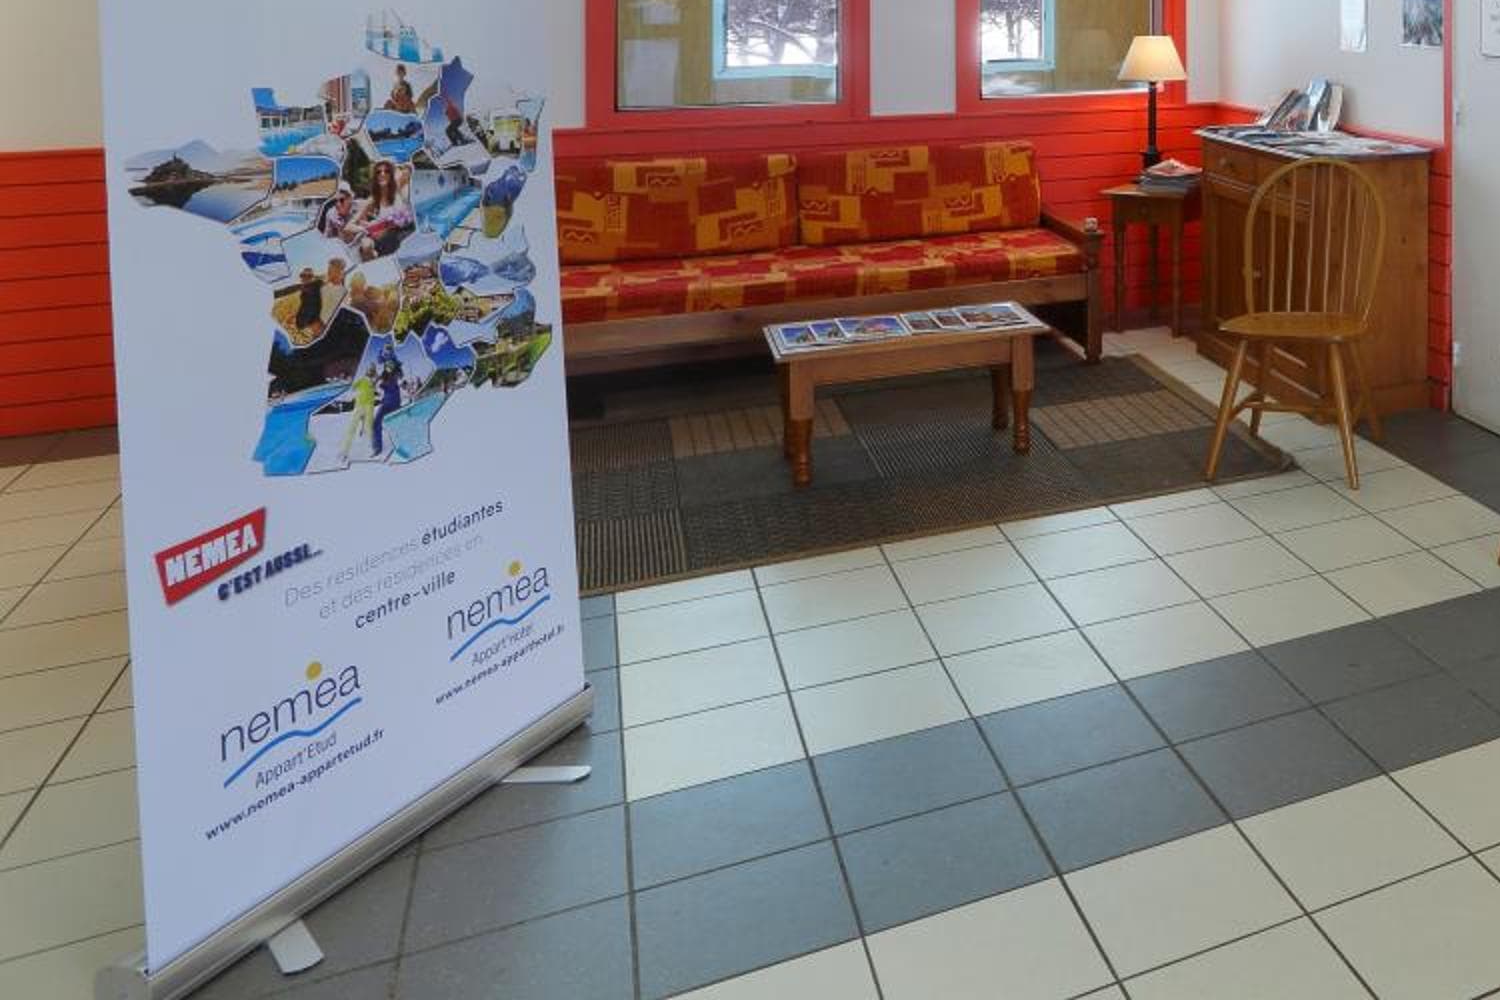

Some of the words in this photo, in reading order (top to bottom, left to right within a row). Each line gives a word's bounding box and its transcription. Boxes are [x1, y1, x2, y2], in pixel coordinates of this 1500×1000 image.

[163, 522, 259, 588] NEMEA
[216, 563, 263, 602] C'EST
[284, 580, 323, 608] Des
[420, 499, 504, 547] étudiantes
[318, 598, 338, 620] et
[340, 583, 373, 610] des
[354, 569, 456, 630] centre-ville
[204, 727, 386, 842] www.nemea-appartetud.fr
